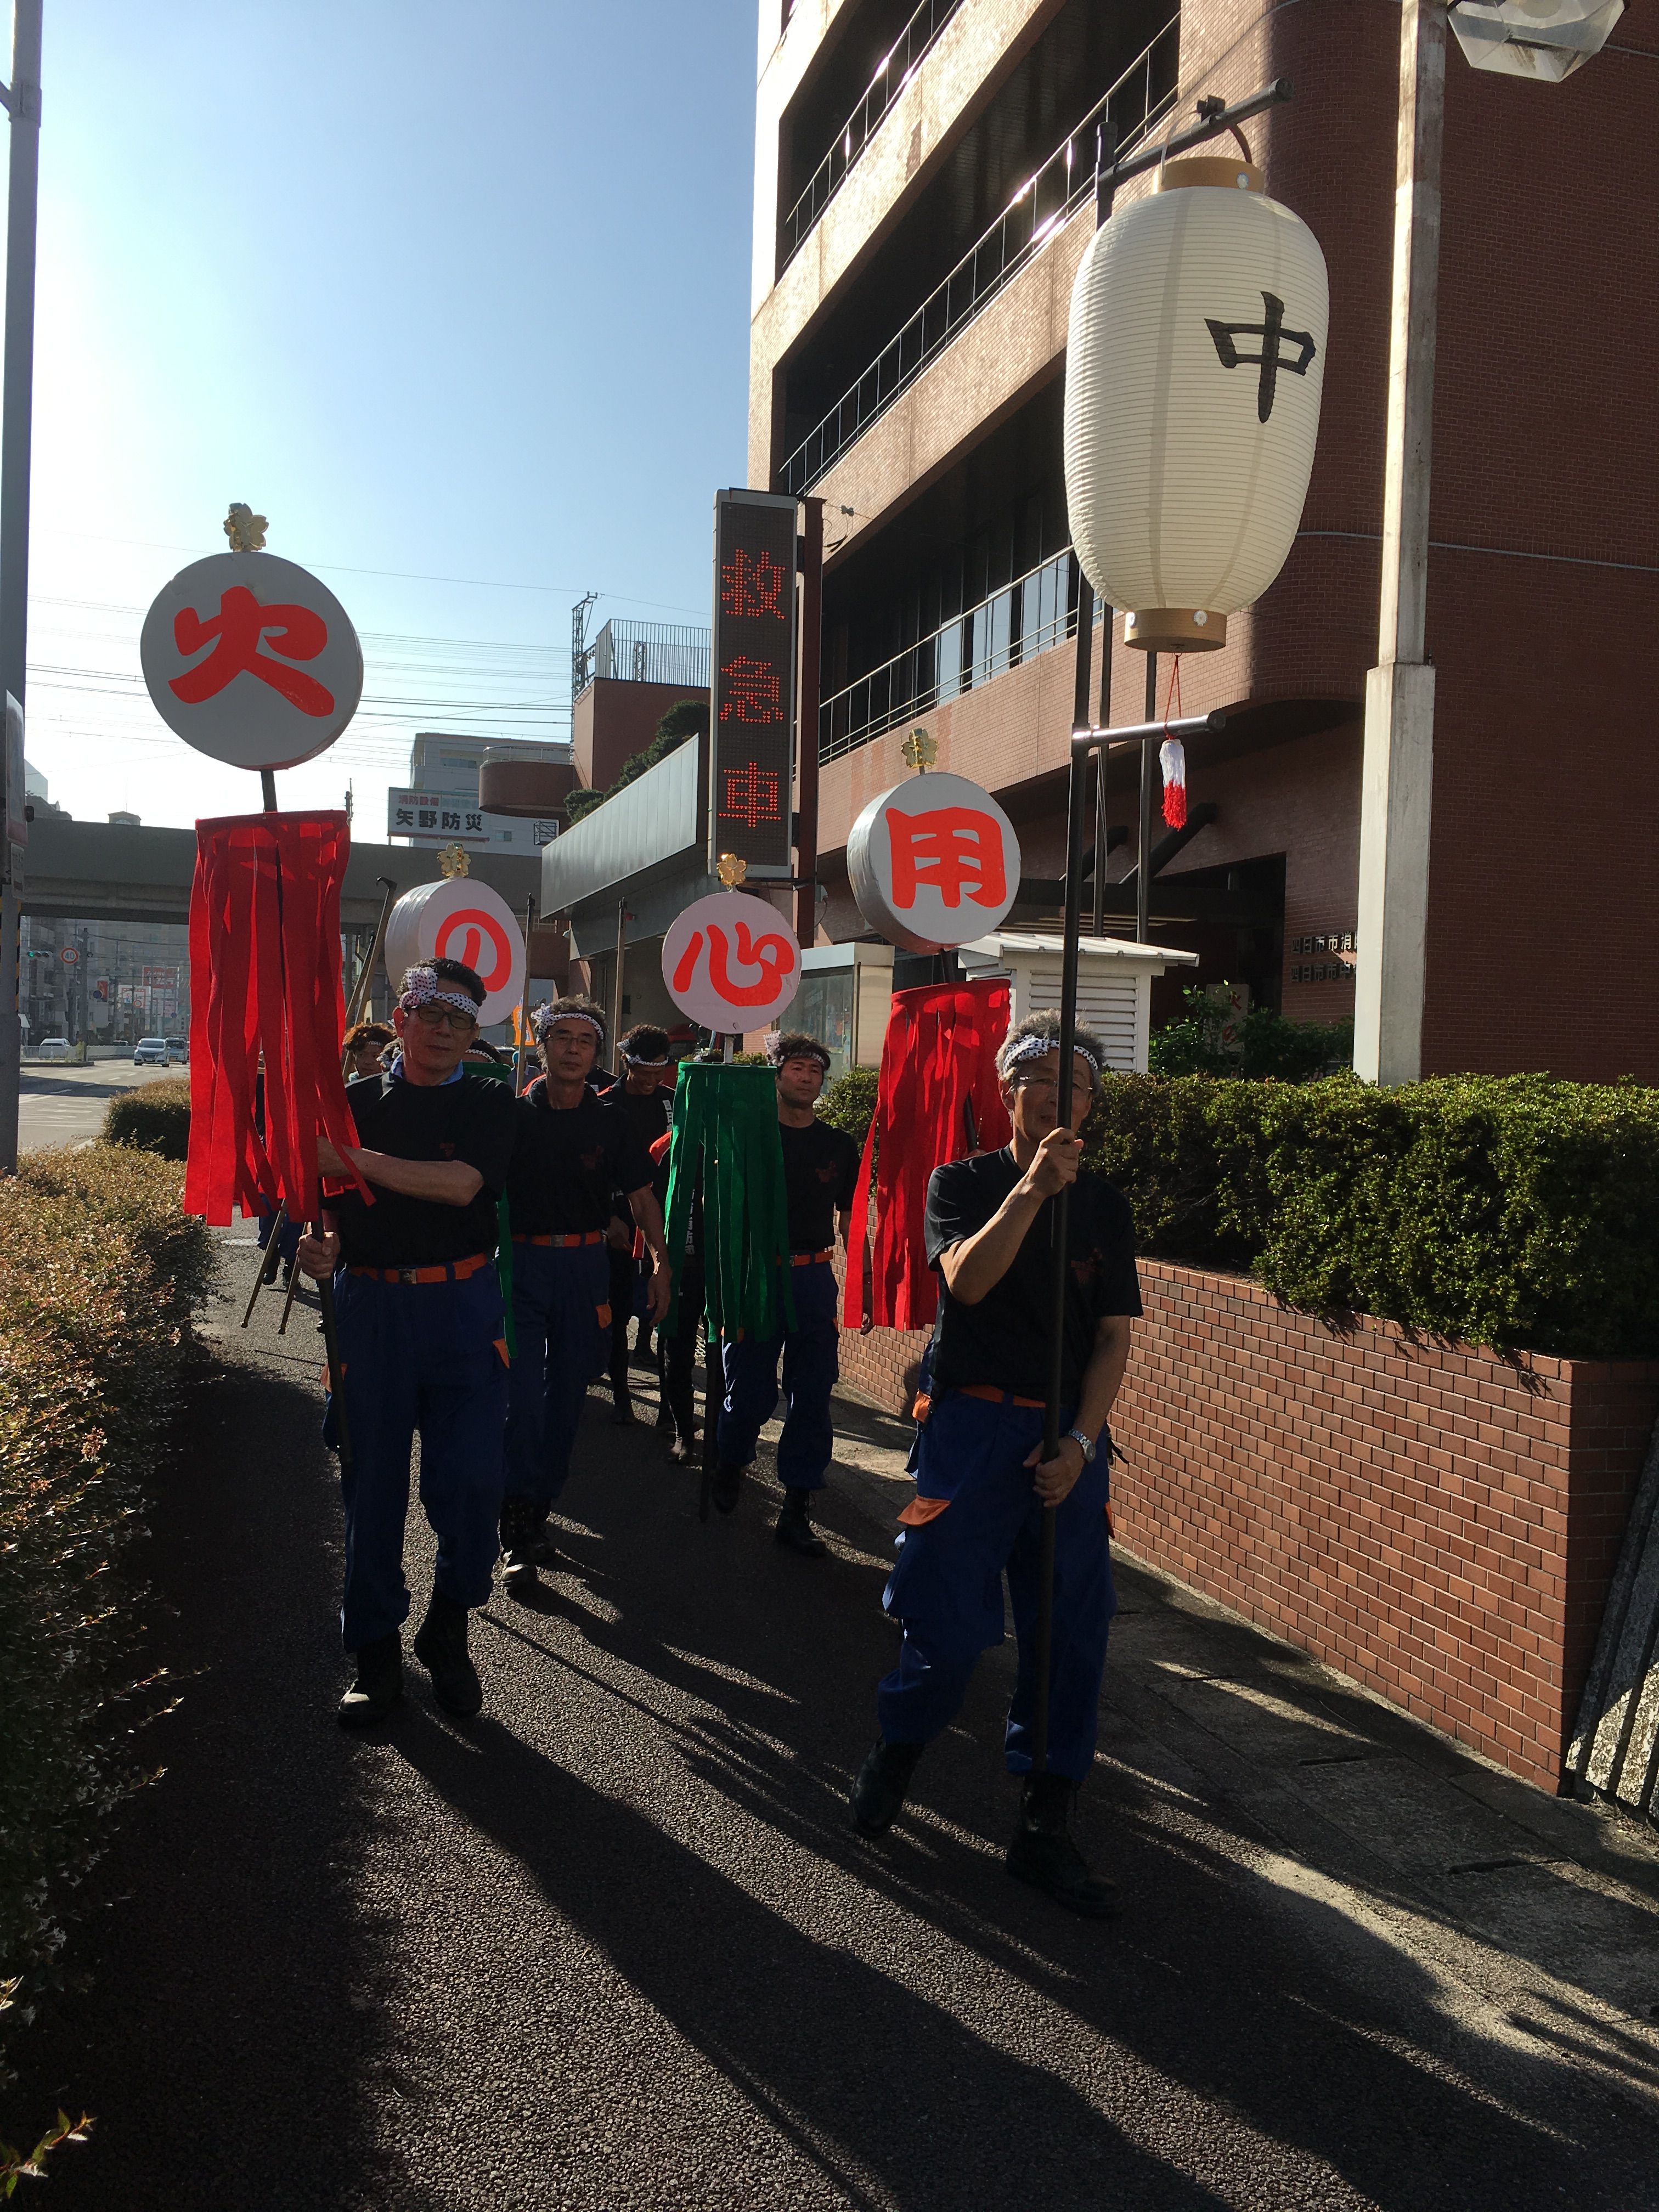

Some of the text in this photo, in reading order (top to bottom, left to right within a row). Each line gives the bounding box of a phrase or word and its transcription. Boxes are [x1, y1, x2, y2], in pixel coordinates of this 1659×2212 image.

[1204, 291, 1316, 424] 中
[168, 585, 335, 718] 火
[718, 549, 786, 828] 救急車
[396, 808, 483, 832] 矢野防災
[885, 806, 1007, 909] 用
[435, 909, 512, 992] の
[673, 921, 795, 1007] 心
[1290, 962, 1357, 983] 四日市市中
[1291, 931, 1358, 954] 四日市市消
